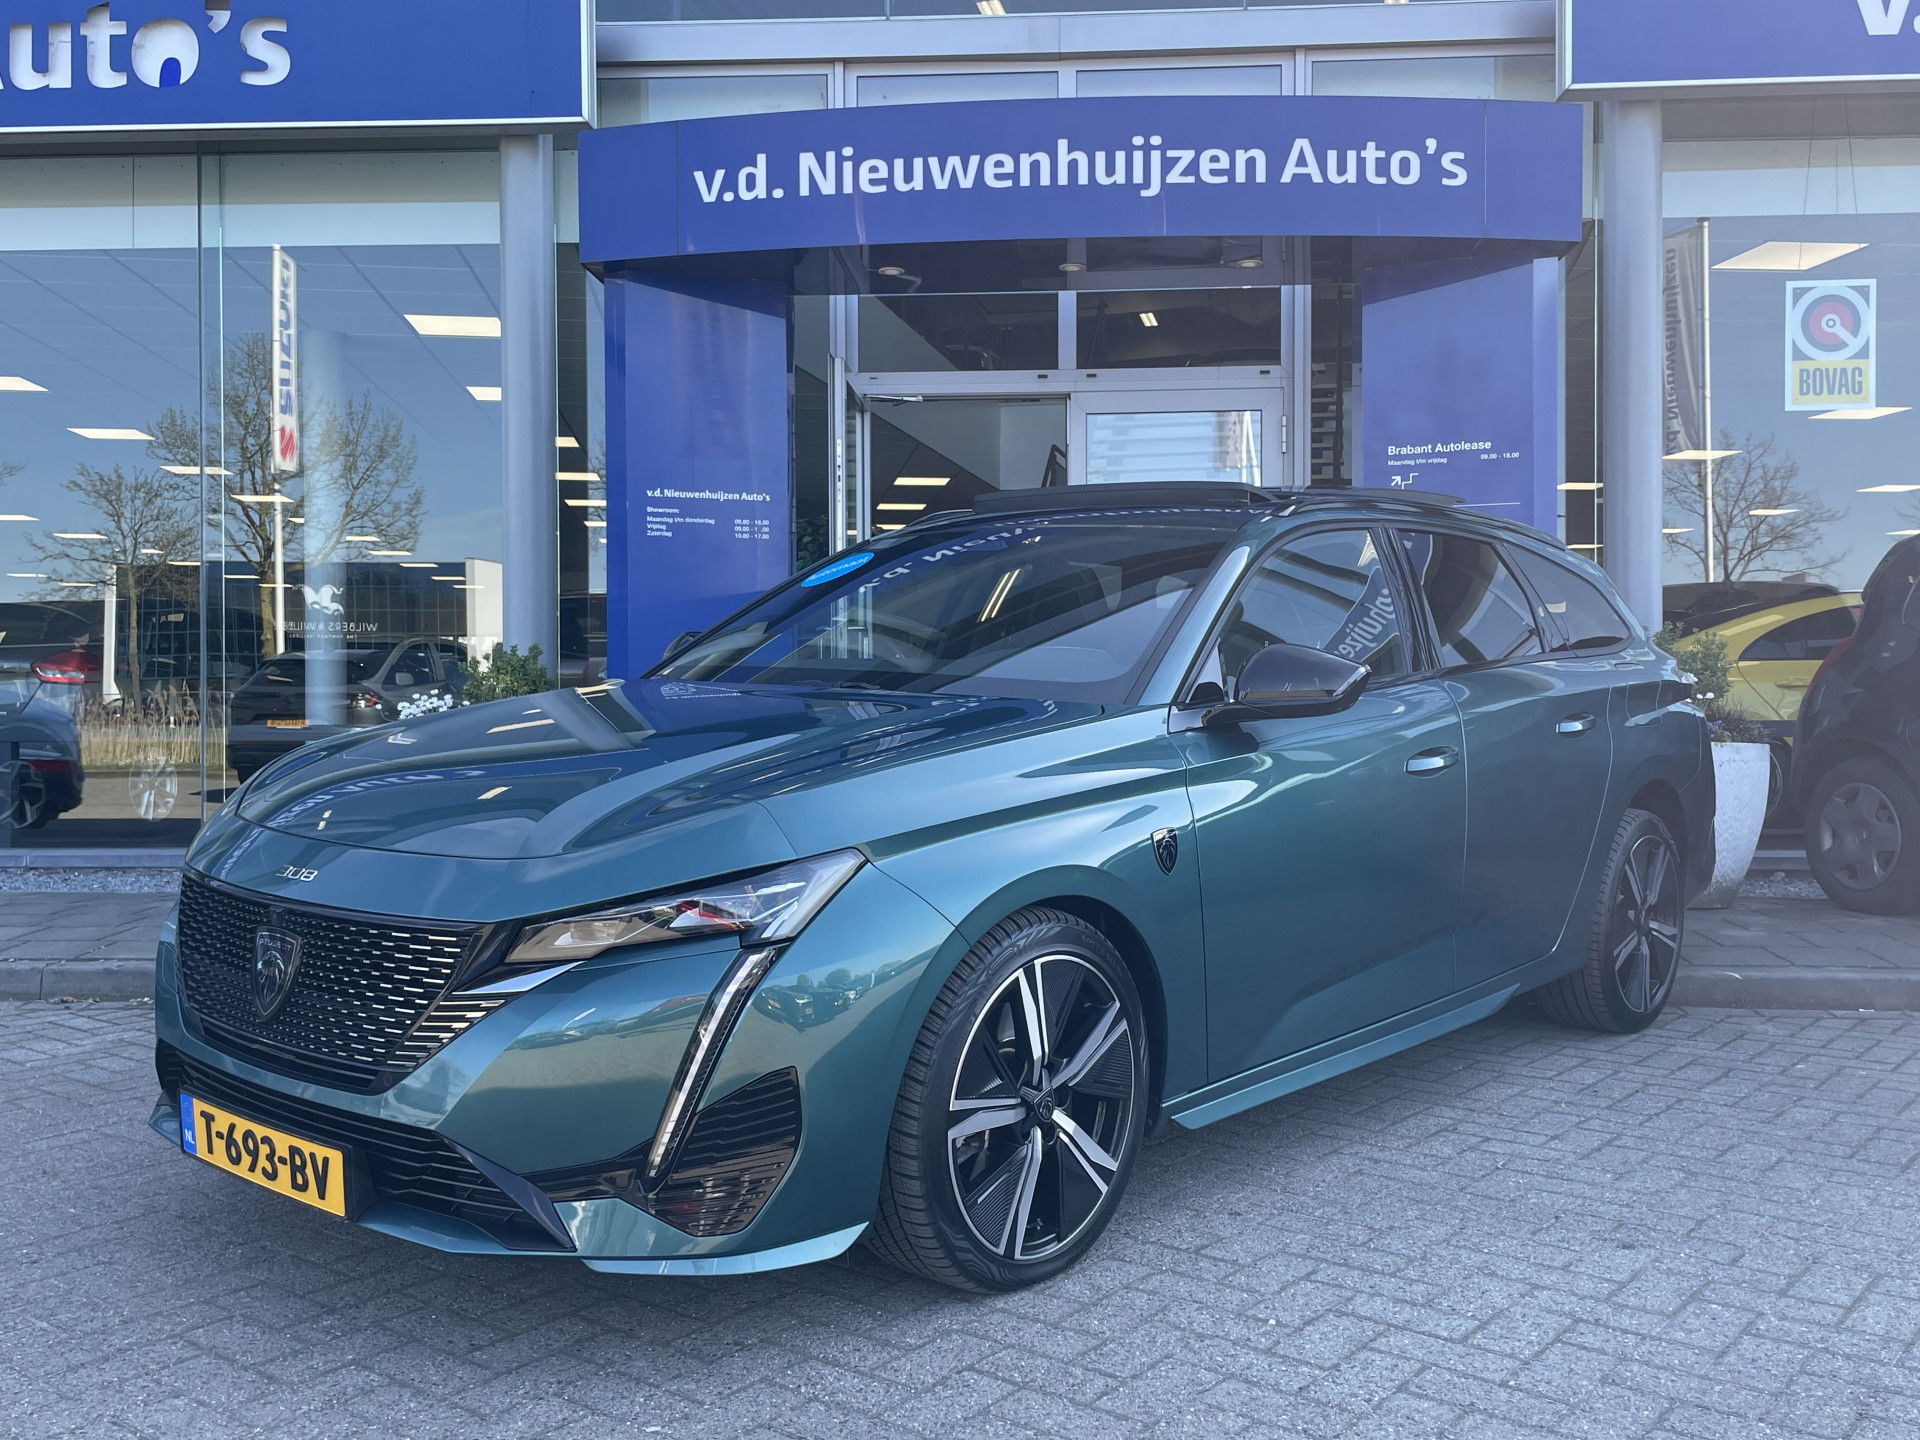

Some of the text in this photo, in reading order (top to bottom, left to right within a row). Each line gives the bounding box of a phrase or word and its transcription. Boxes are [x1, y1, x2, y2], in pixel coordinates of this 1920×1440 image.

[0, 2, 291, 90] uto's
[694, 135, 1468, 203] v.d. Nieuwenhuijzen Auto's
[1799, 366, 1863, 396] BOVAG
[1388, 440, 1492, 456] Brabant Autolease
[1388, 459, 1415, 467] Maandag
[646, 488, 771, 502] v.d. Nieuwenhuijzen Auto's
[275, 864, 319, 882] 308
[184, 1128, 195, 1145] NL
[199, 1109, 330, 1201] T-693-BV
